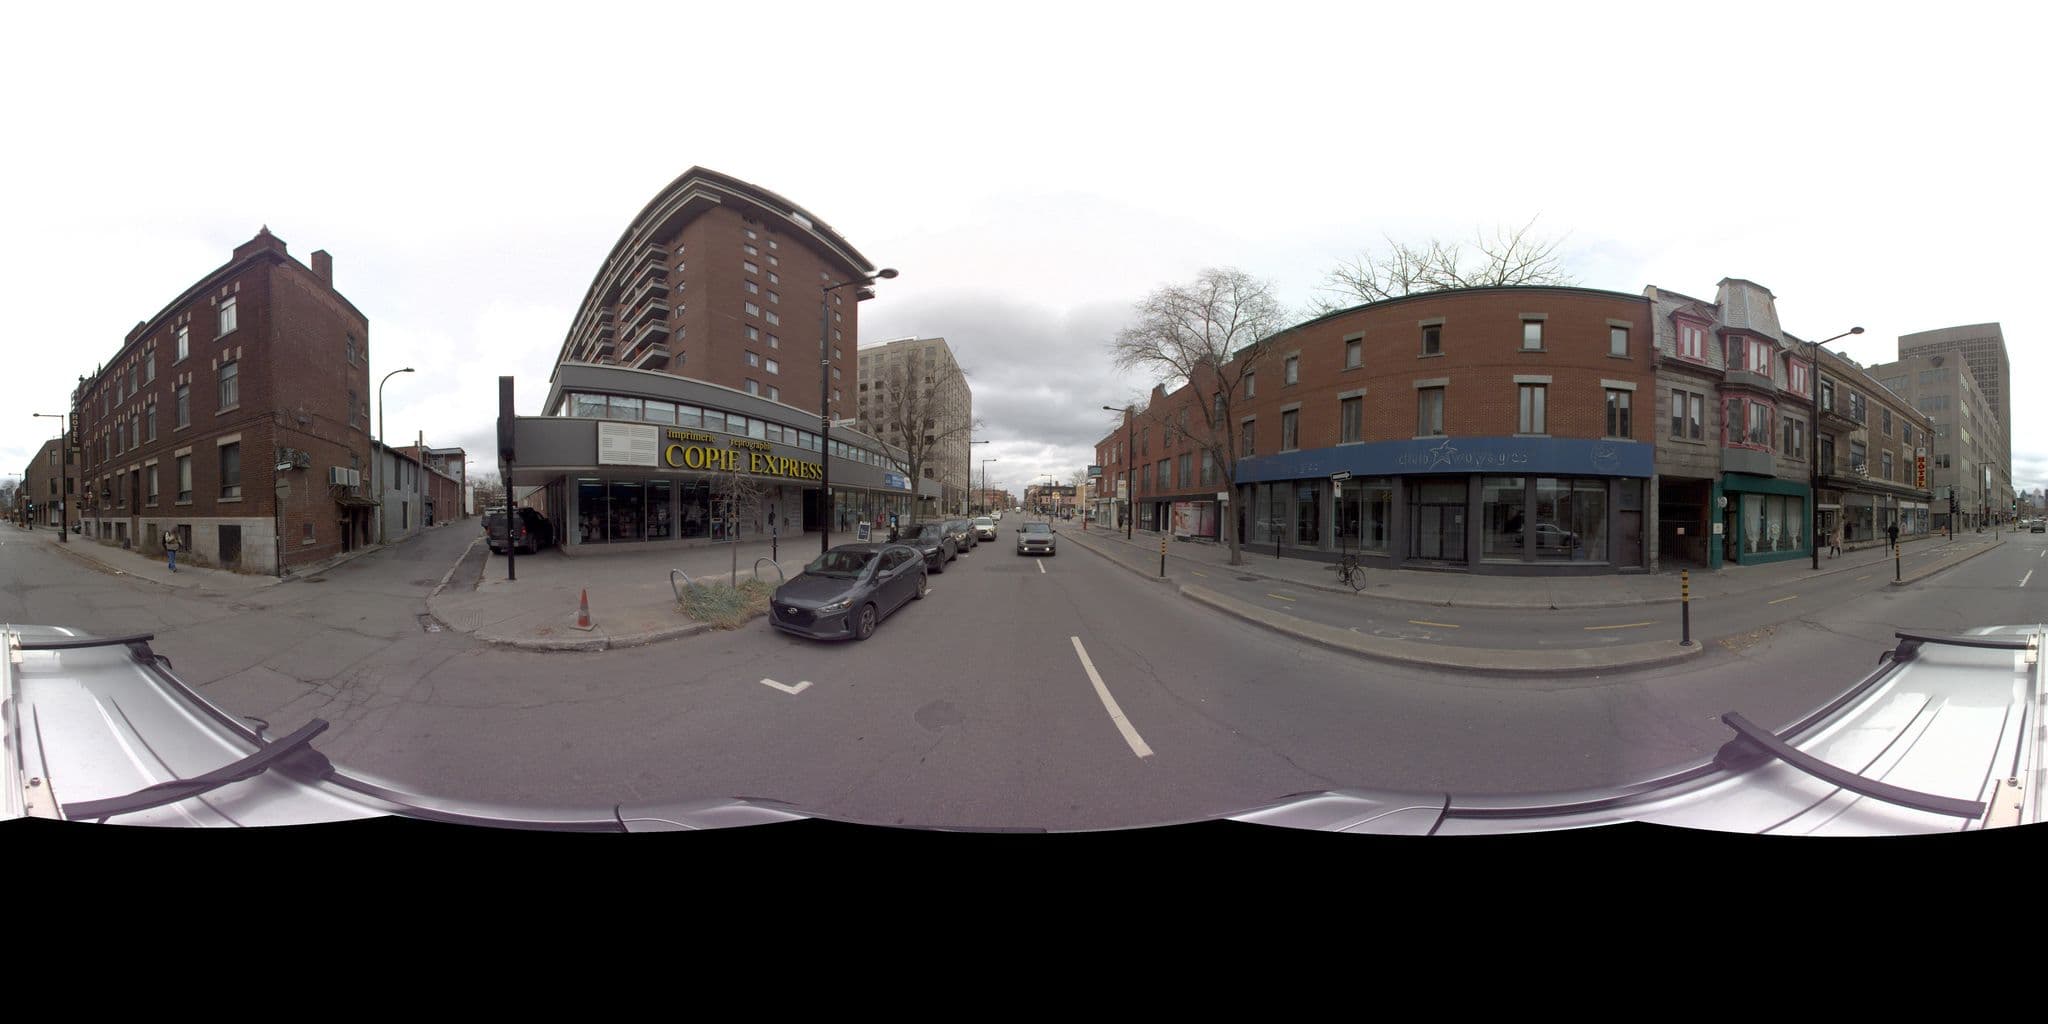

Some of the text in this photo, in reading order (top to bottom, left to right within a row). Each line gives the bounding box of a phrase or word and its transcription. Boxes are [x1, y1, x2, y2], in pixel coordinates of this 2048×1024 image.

[666, 428, 716, 443] imprimerie
[665, 443, 741, 472] COPIE
[750, 452, 822, 480] EXPRESS
